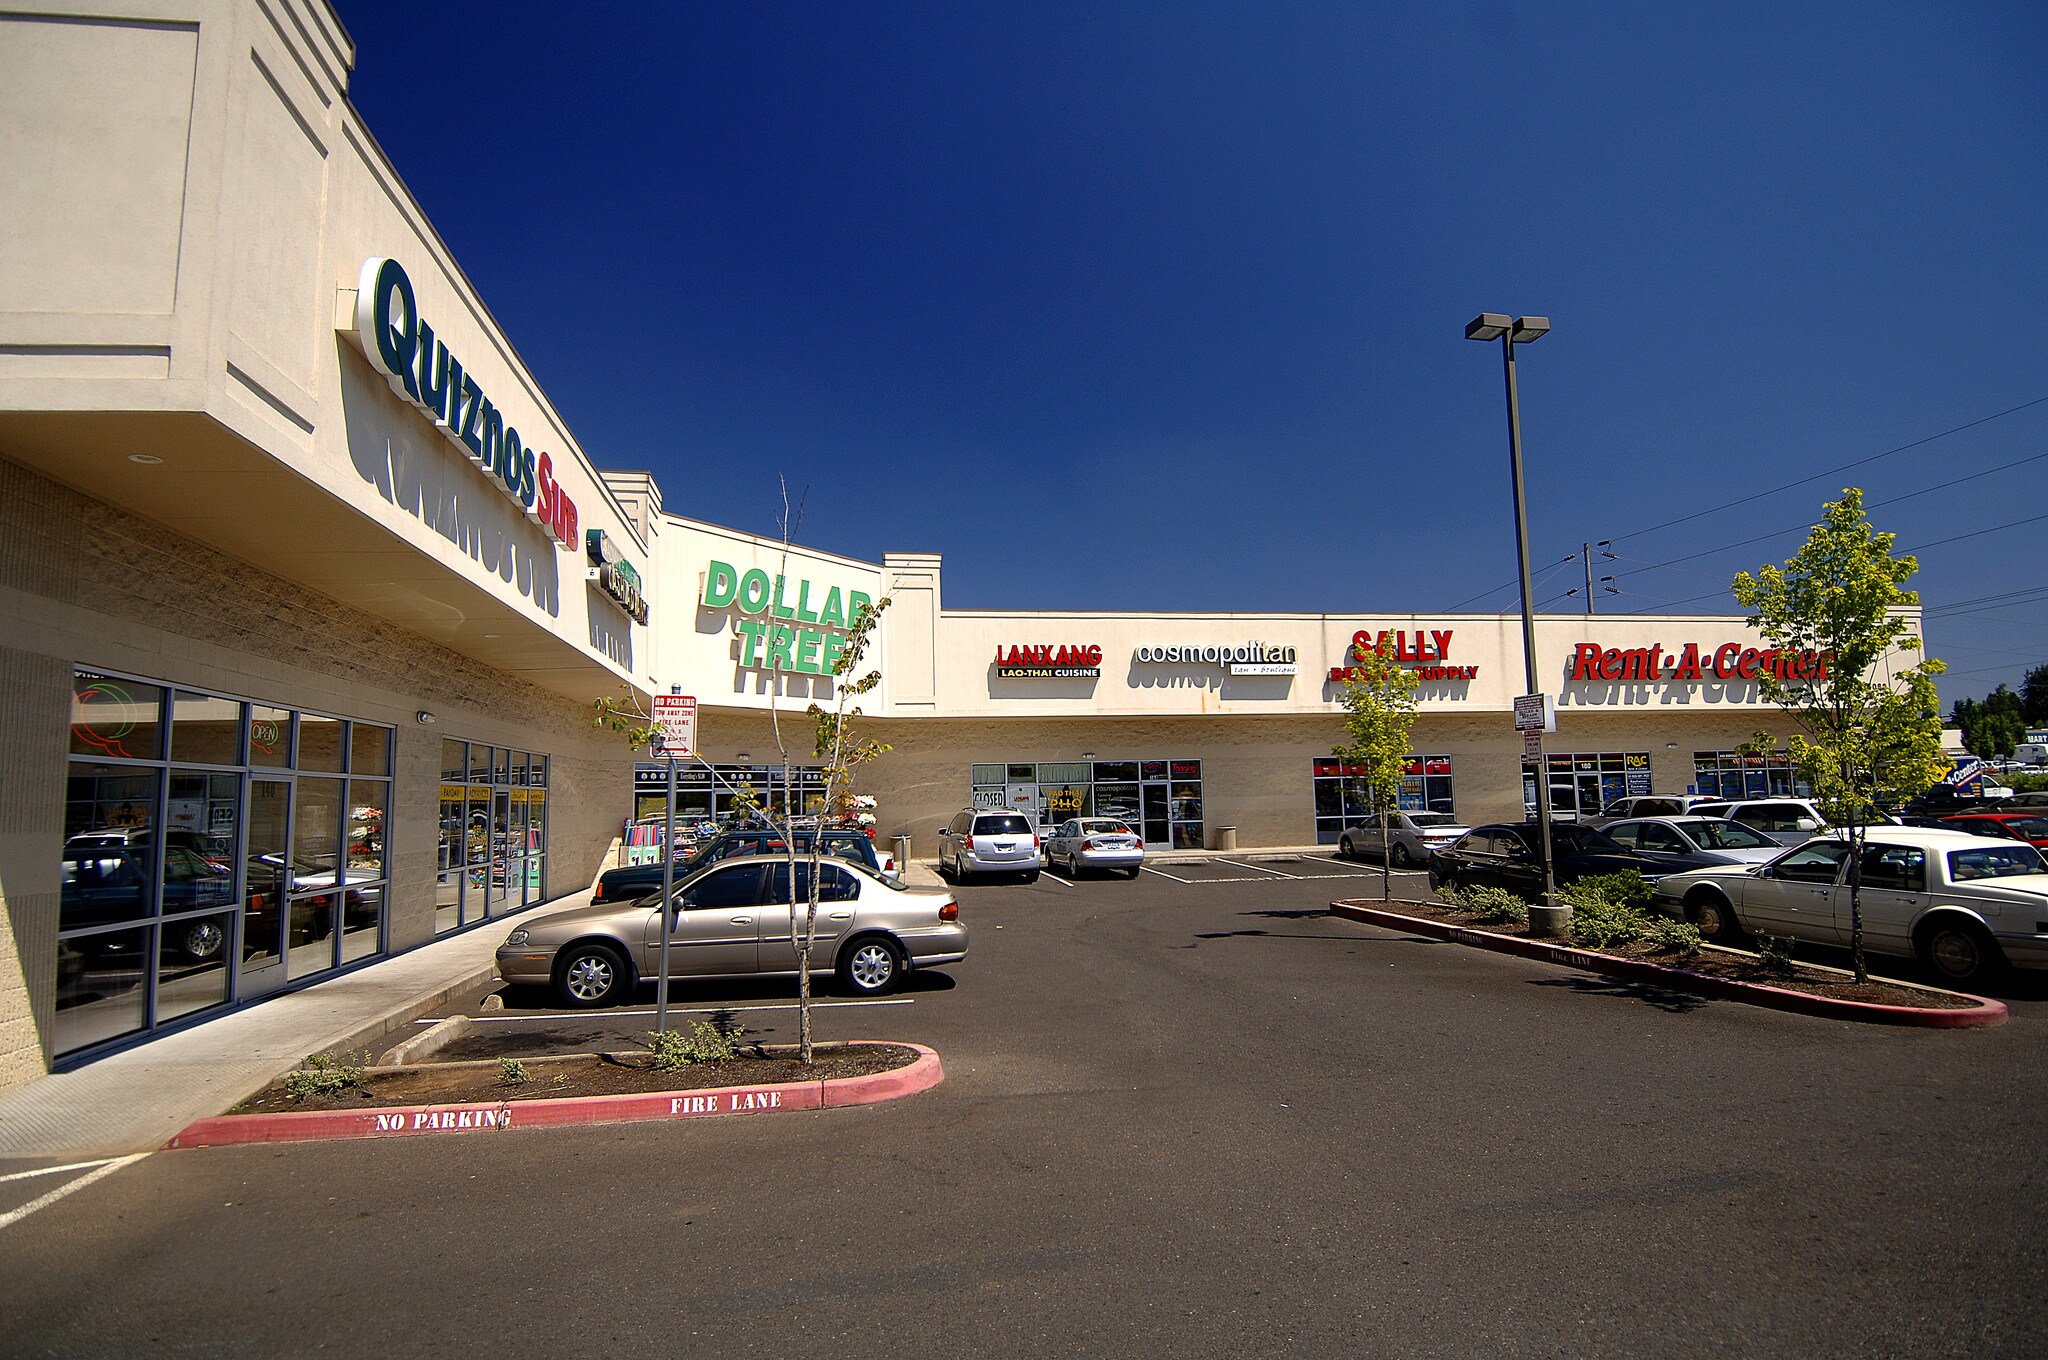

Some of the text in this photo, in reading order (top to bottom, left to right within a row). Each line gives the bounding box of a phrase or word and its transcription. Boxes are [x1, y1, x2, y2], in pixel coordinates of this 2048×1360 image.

[532, 451, 578, 552] SUB
[703, 559, 871, 630] DOLLAR
[738, 620, 847, 676] TREE
[997, 644, 1103, 667] LANXANG
[1136, 640, 1298, 668] cosmopolitan
[1352, 630, 1453, 662] SALLY
[1001, 668, 1098, 678] LAO-THAI CUISINE
[1413, 665, 1480, 681] SUPPLY
[666, 698, 695, 706] PARKING
[252, 724, 276, 741] OPEN
[1627, 755, 1648, 767] RAC
[1049, 798, 1083, 808] PHO
[670, 1091, 782, 1115] FIRE LANE
[376, 1109, 512, 1131] NO PARKING
